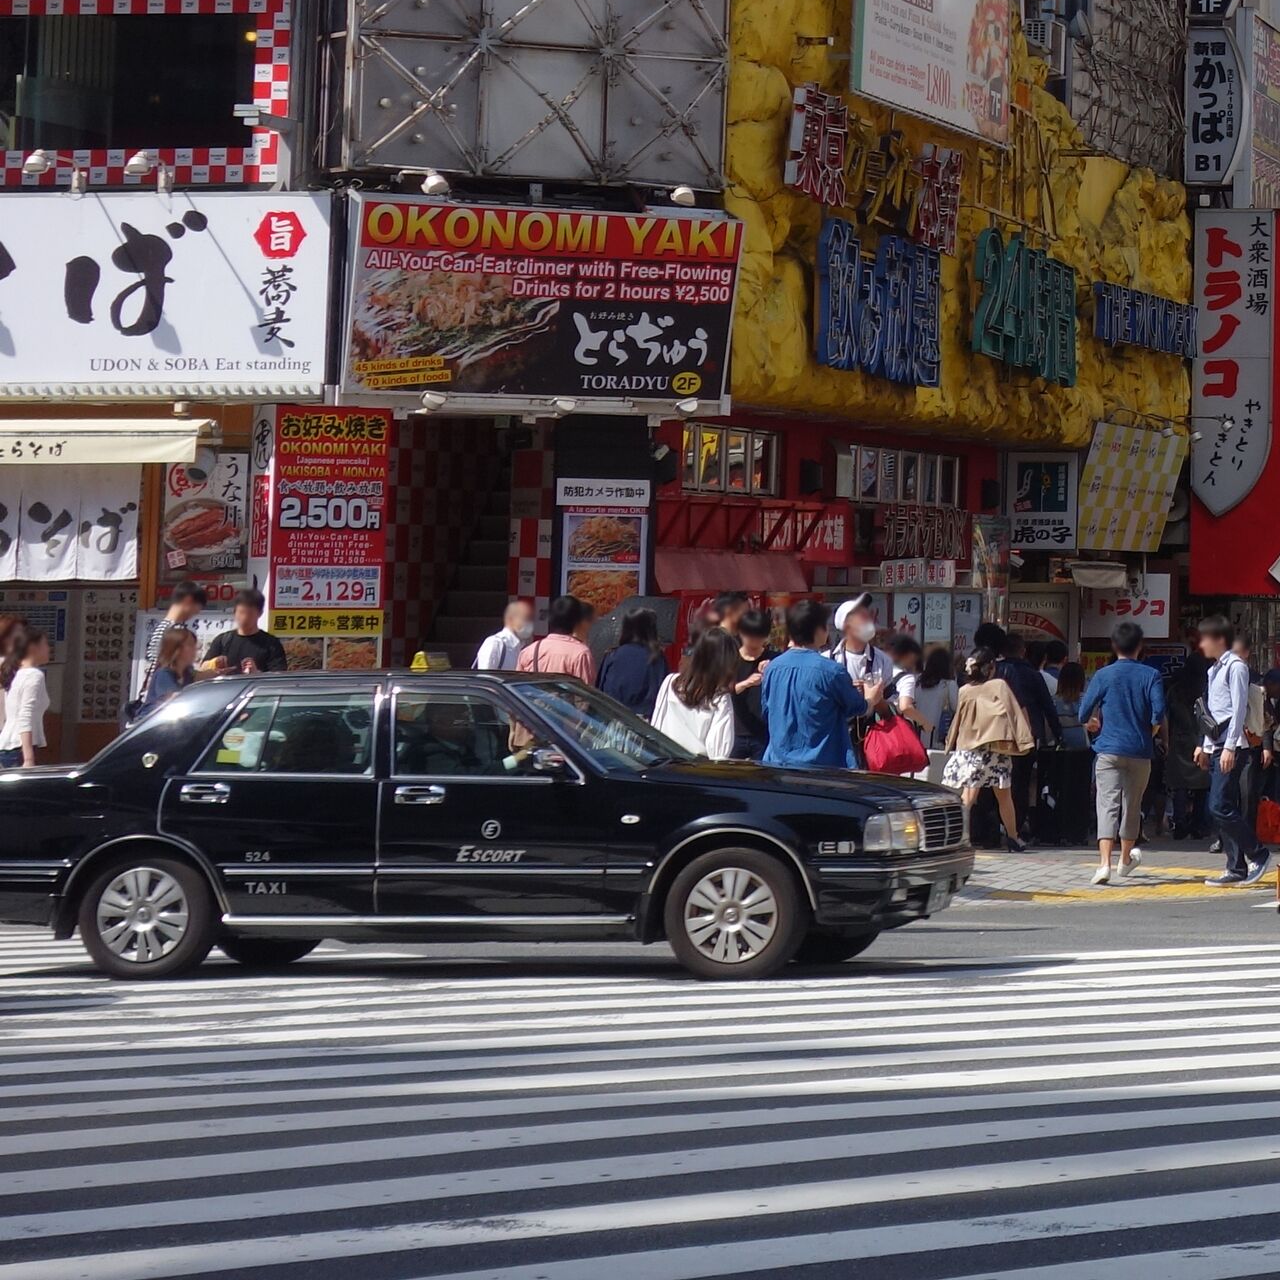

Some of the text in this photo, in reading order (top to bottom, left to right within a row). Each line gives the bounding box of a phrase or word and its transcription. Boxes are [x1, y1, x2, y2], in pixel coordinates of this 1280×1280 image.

[1193, 41, 1226, 56] 新宿
[1192, 58, 1226, 145] かっぱ
[1194, 154, 1223, 172] B1
[367, 203, 739, 258] OKONOMI YAKI
[517, 260, 574, 277] dinner
[578, 262, 615, 278] with
[620, 262, 732, 284] Free-Flowing
[1247, 217, 1271, 316] 大衆酒場
[512, 279, 730, 304] Drinks for 2 hours ¥2,500
[257, 265, 298, 348] 蕎麦
[1202, 227, 1242, 398] トラノコ
[89, 357, 312, 377] UDON & SOBA Eat standing
[370, 359, 396, 372] kinds
[411, 357, 443, 369] drinks
[381, 375, 408, 387] kinds
[422, 371, 449, 383] foods
[581, 374, 698, 391] TORADYU 2F
[280, 416, 387, 440] お好み焼き
[1231, 399, 1262, 472] やきとり
[280, 442, 386, 456] OKONOMI YAKI
[564, 486, 646, 499] 防犯カメラ作動中
[1011, 527, 1073, 544] 虎の子
[245, 851, 271, 862] 524
[245, 882, 287, 895] TAXI
